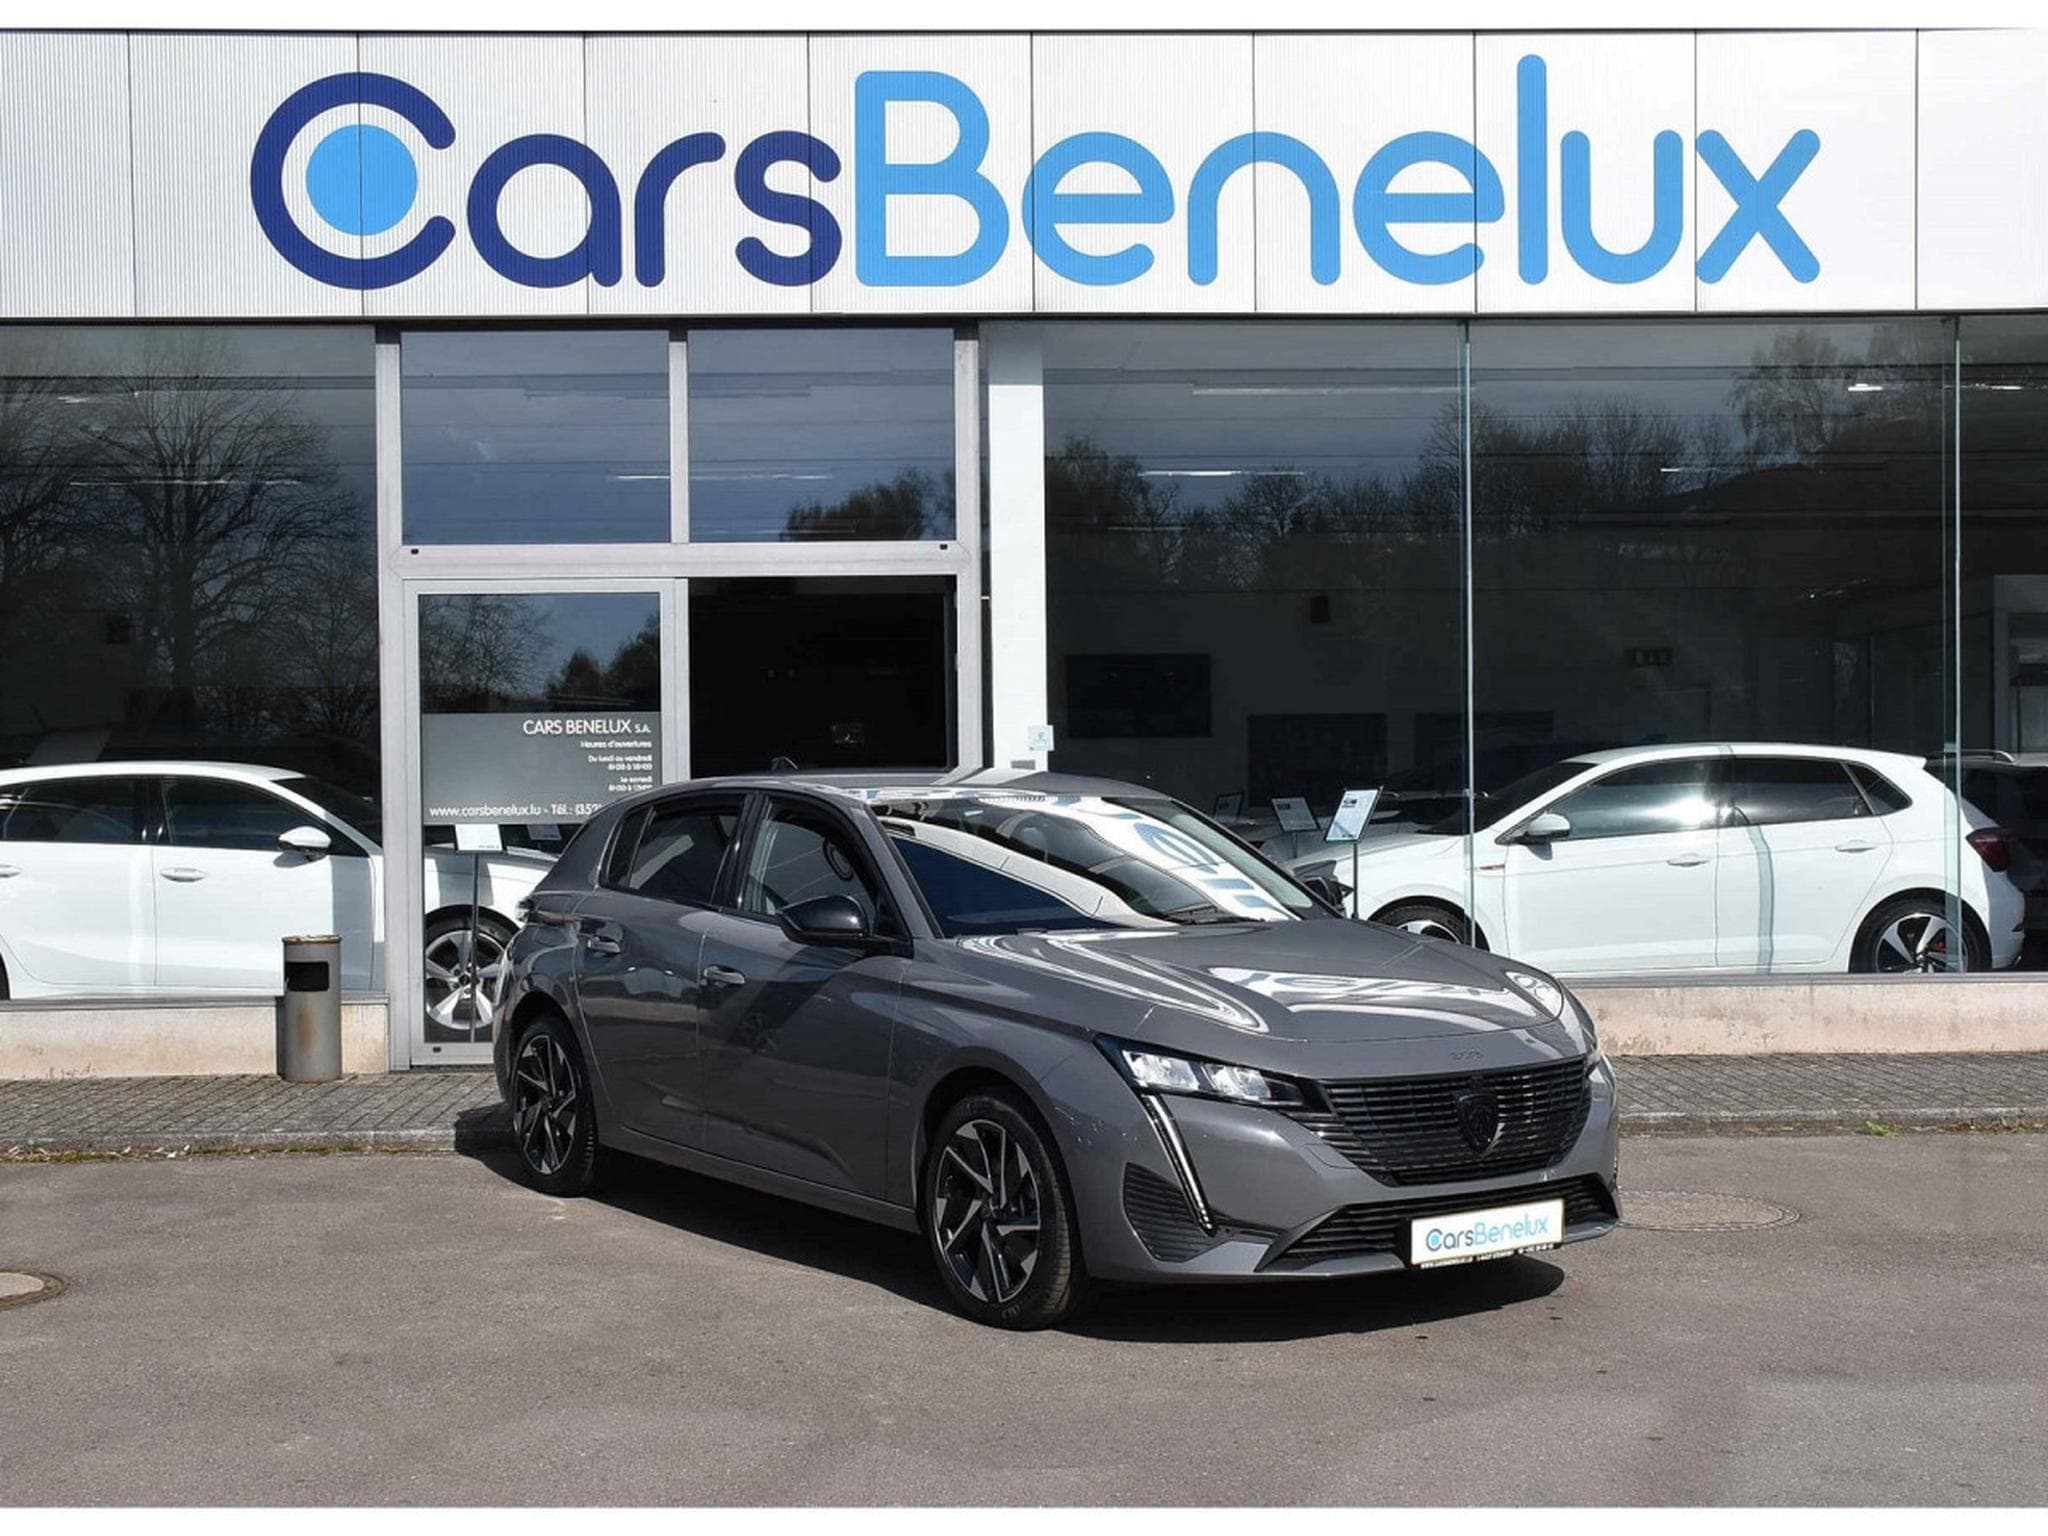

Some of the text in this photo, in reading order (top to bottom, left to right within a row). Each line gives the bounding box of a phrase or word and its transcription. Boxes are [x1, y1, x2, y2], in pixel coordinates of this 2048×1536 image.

[251, 55, 1818, 288] CarsBenelux
[523, 719, 562, 735] CARS
[565, 719, 632, 735] BENELUX
[430, 804, 541, 816] www.carsbenelux.lu
[1425, 1214, 1548, 1252] CarsBenelux
